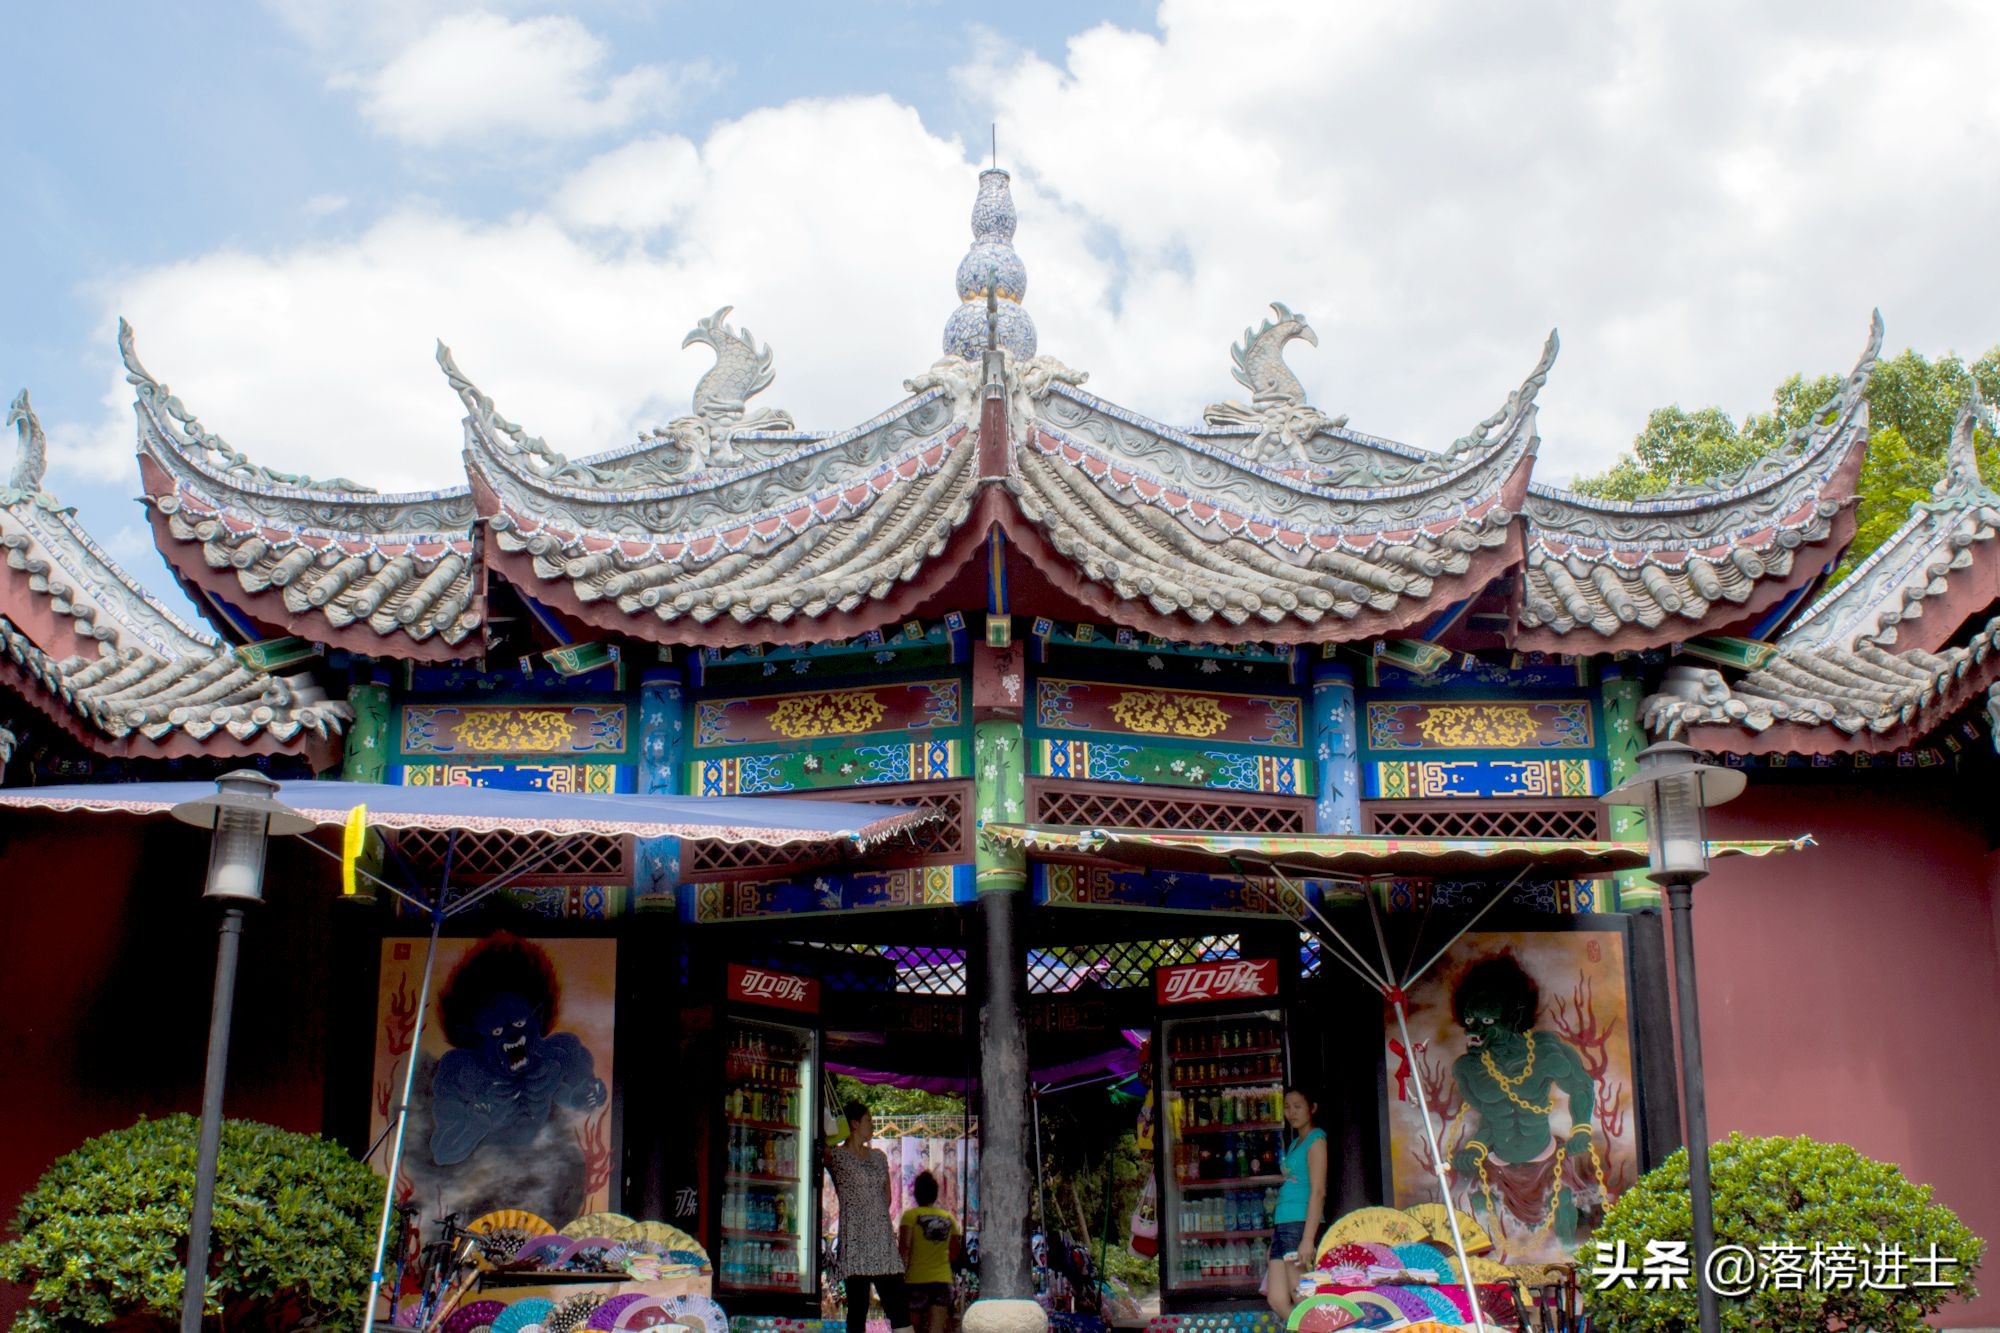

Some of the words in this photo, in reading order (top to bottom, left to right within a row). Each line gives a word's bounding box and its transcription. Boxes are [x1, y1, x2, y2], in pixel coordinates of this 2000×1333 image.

[741, 970, 809, 1001] 可口可乐
[1165, 960, 1270, 1002] 可口可乐
